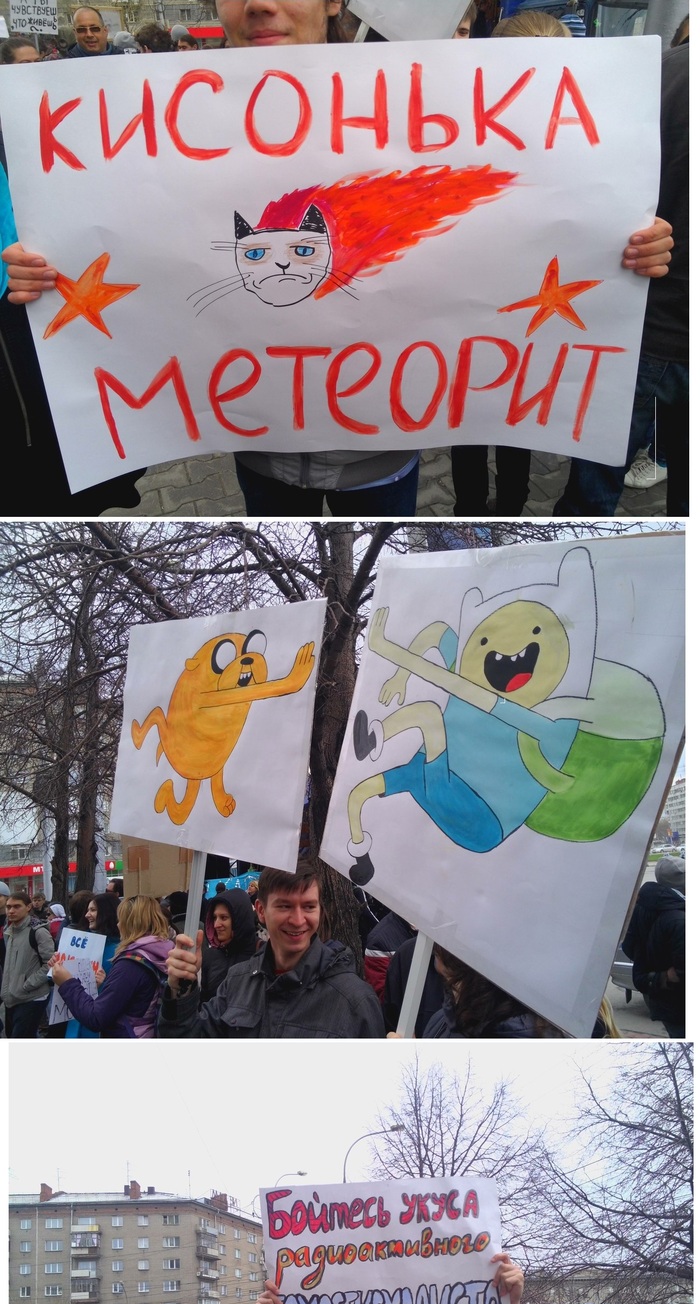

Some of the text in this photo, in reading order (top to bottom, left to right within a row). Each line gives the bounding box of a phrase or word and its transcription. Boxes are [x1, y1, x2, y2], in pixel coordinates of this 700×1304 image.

[38, 62, 601, 174] КИСОНЬКА
[70, 935, 88, 949] ВСЁ
[266, 1189, 391, 1240] Бойтесь
[274, 1226, 491, 1290] радиоактивного
